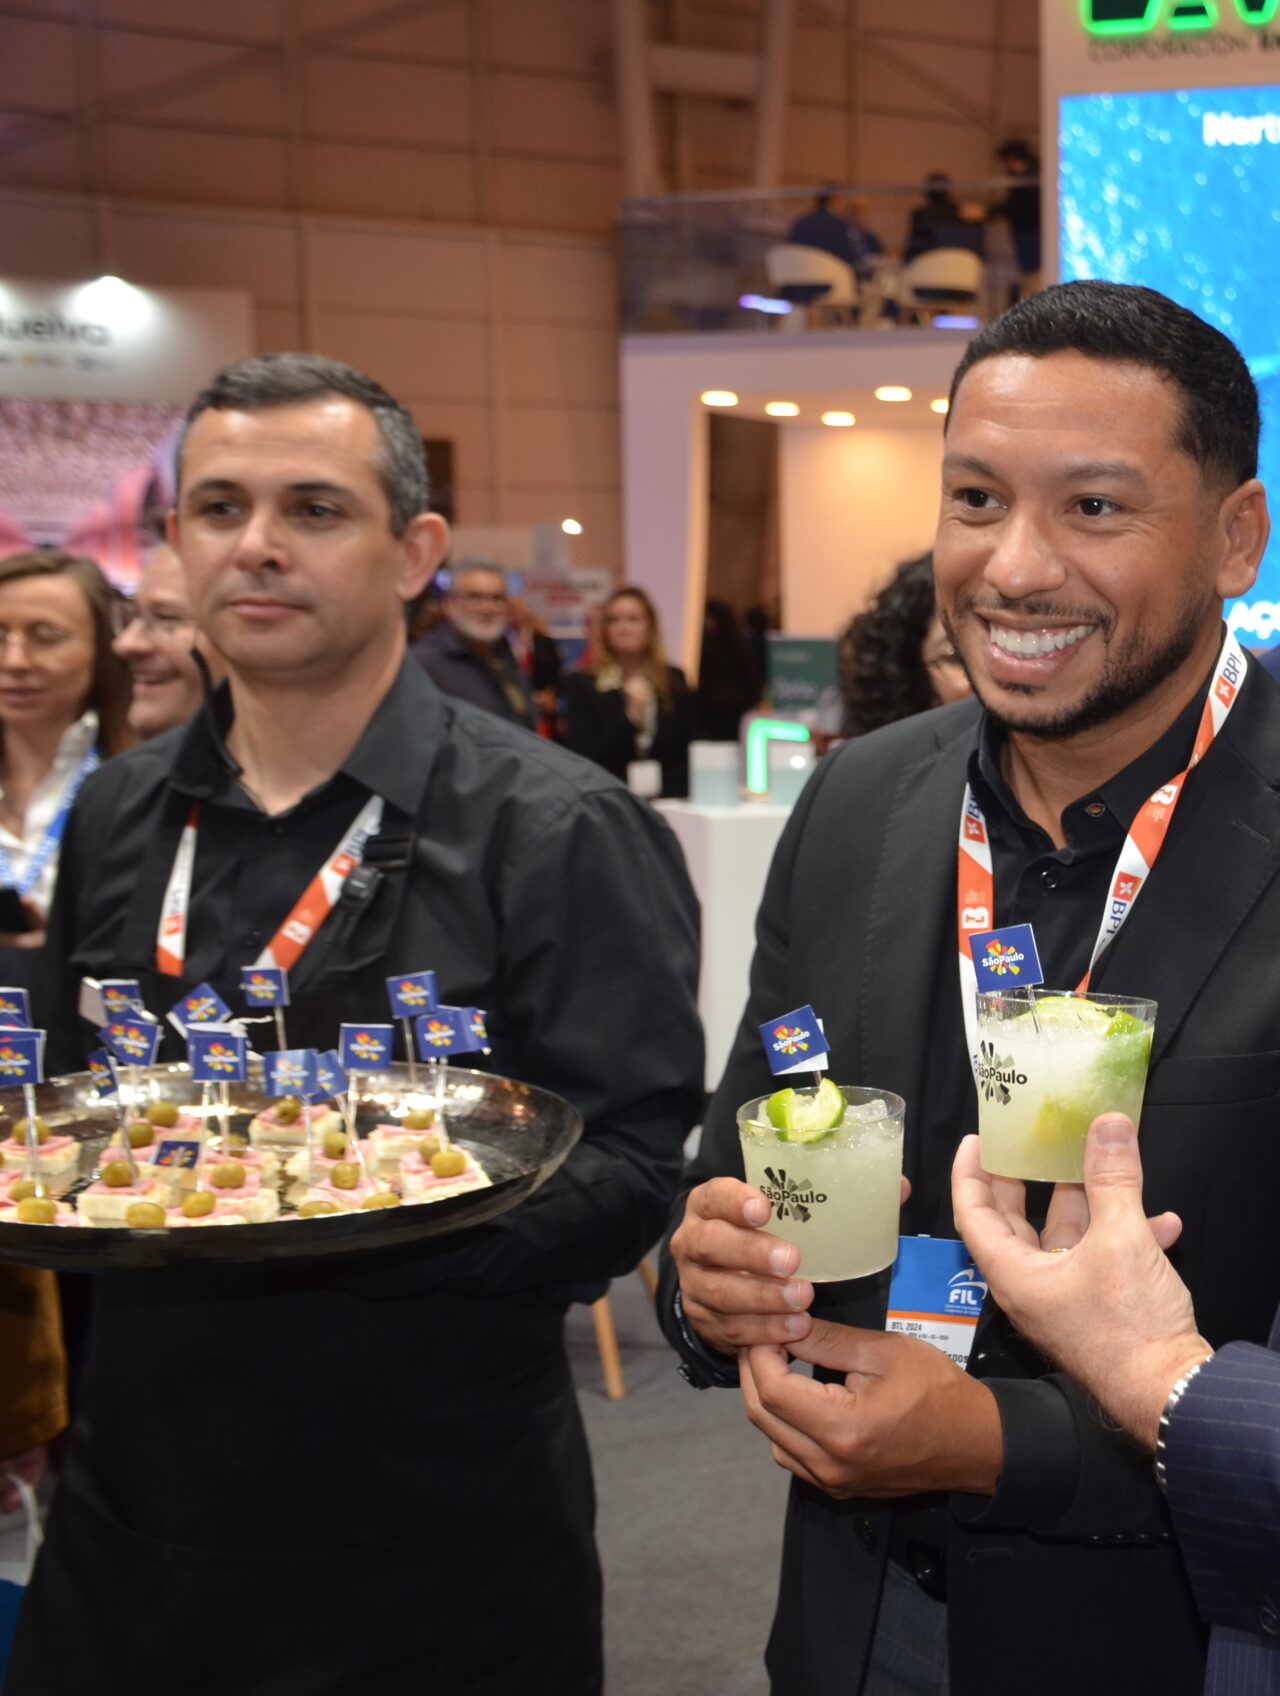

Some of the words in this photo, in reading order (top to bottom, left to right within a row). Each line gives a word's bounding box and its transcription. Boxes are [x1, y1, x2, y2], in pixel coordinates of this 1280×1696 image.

[1222, 652, 1243, 685] BPI
[1106, 900, 1127, 935] BPI
[982, 952, 1025, 968] SãoPaulo
[773, 1029, 810, 1051] SãoPaulo
[949, 1288, 977, 1305] FIL
[891, 1321, 904, 1331] BTL
[905, 1321, 922, 1332] 2024
